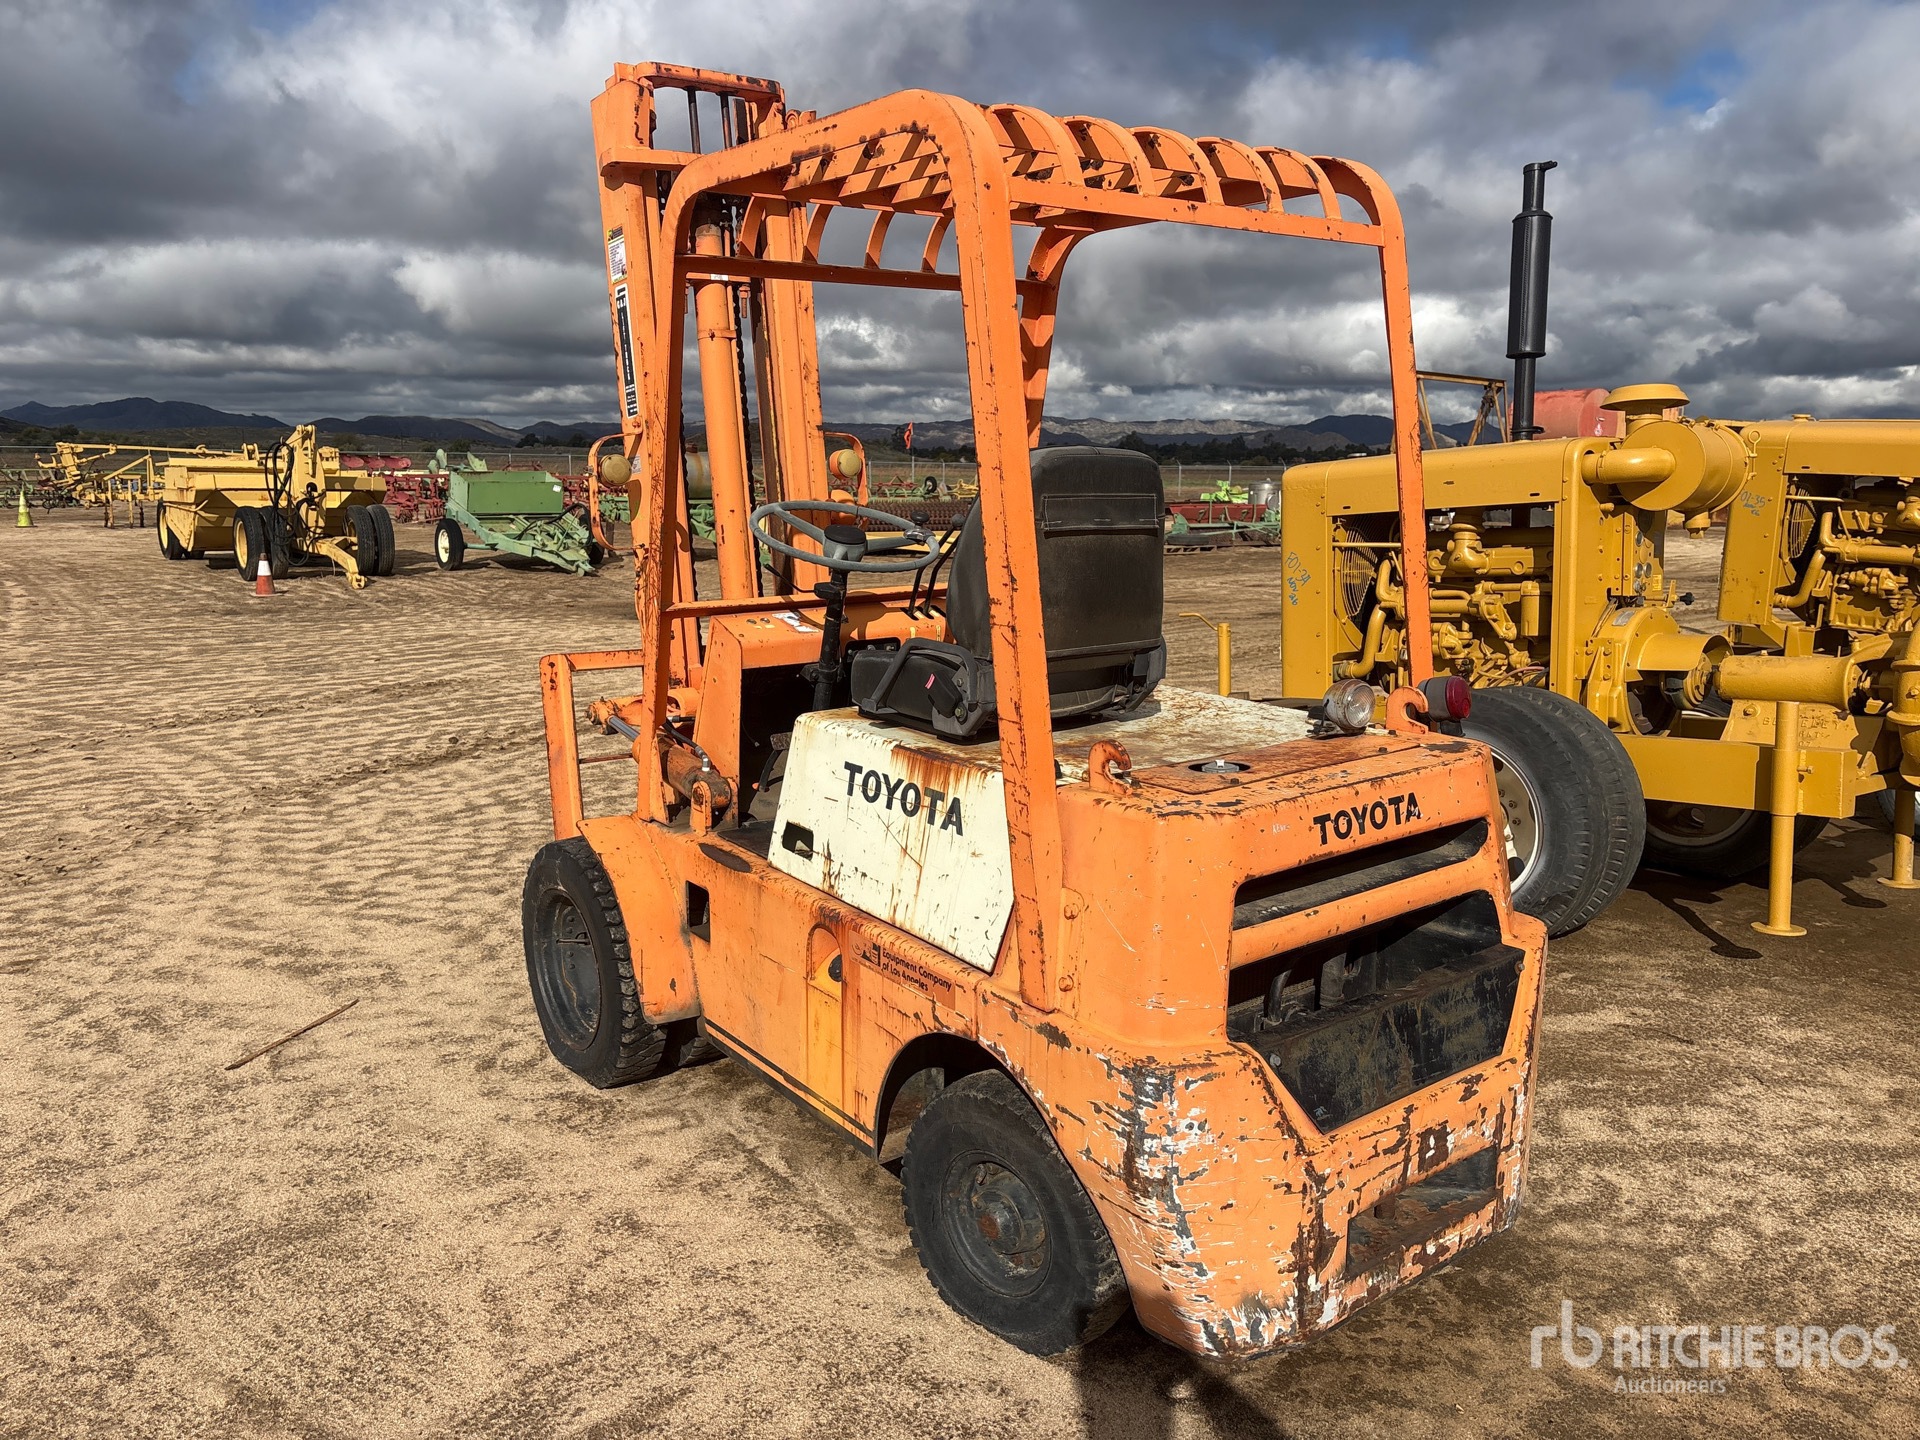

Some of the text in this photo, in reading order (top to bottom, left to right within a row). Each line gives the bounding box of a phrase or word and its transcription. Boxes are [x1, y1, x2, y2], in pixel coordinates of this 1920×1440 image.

[844, 761, 963, 837] TOYOTA
[1313, 792, 1422, 845] TOYOTA
[882, 947, 917, 974] Equipment
[918, 965, 952, 992] Company
[882, 962, 890, 972] of
[890, 963, 901, 978] Los
